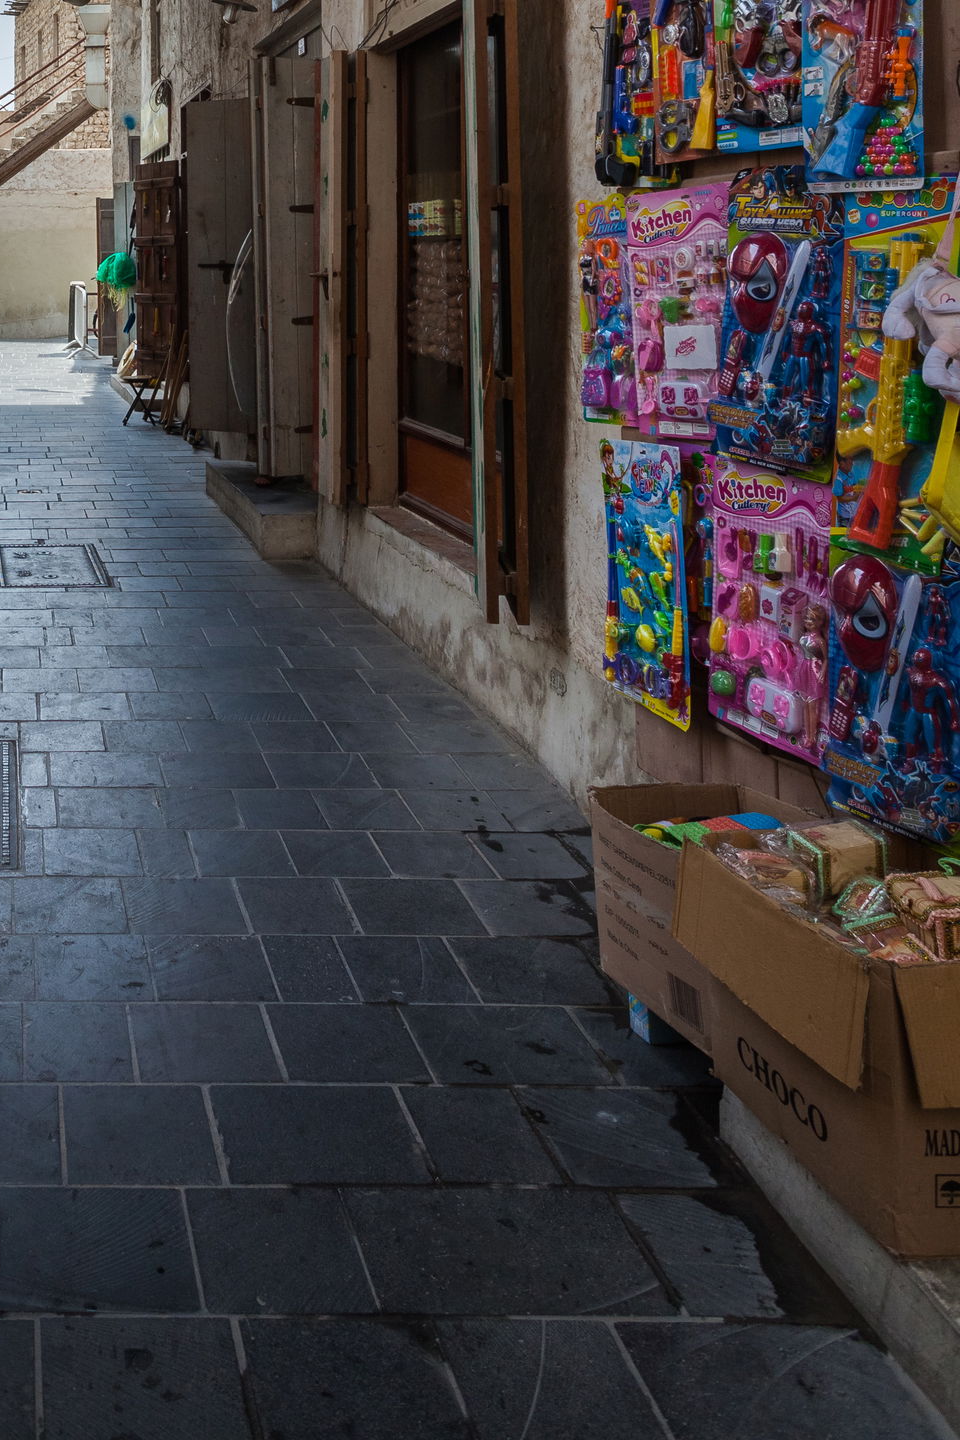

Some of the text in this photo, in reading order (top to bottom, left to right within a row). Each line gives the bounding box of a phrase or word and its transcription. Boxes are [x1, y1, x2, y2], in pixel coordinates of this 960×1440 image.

[631, 208, 692, 239] Kitchen
[880, 210, 929, 218] SUPERGUN!
[718, 478, 787, 503] Kitchen
[737, 1036, 828, 1142] CHOCO
